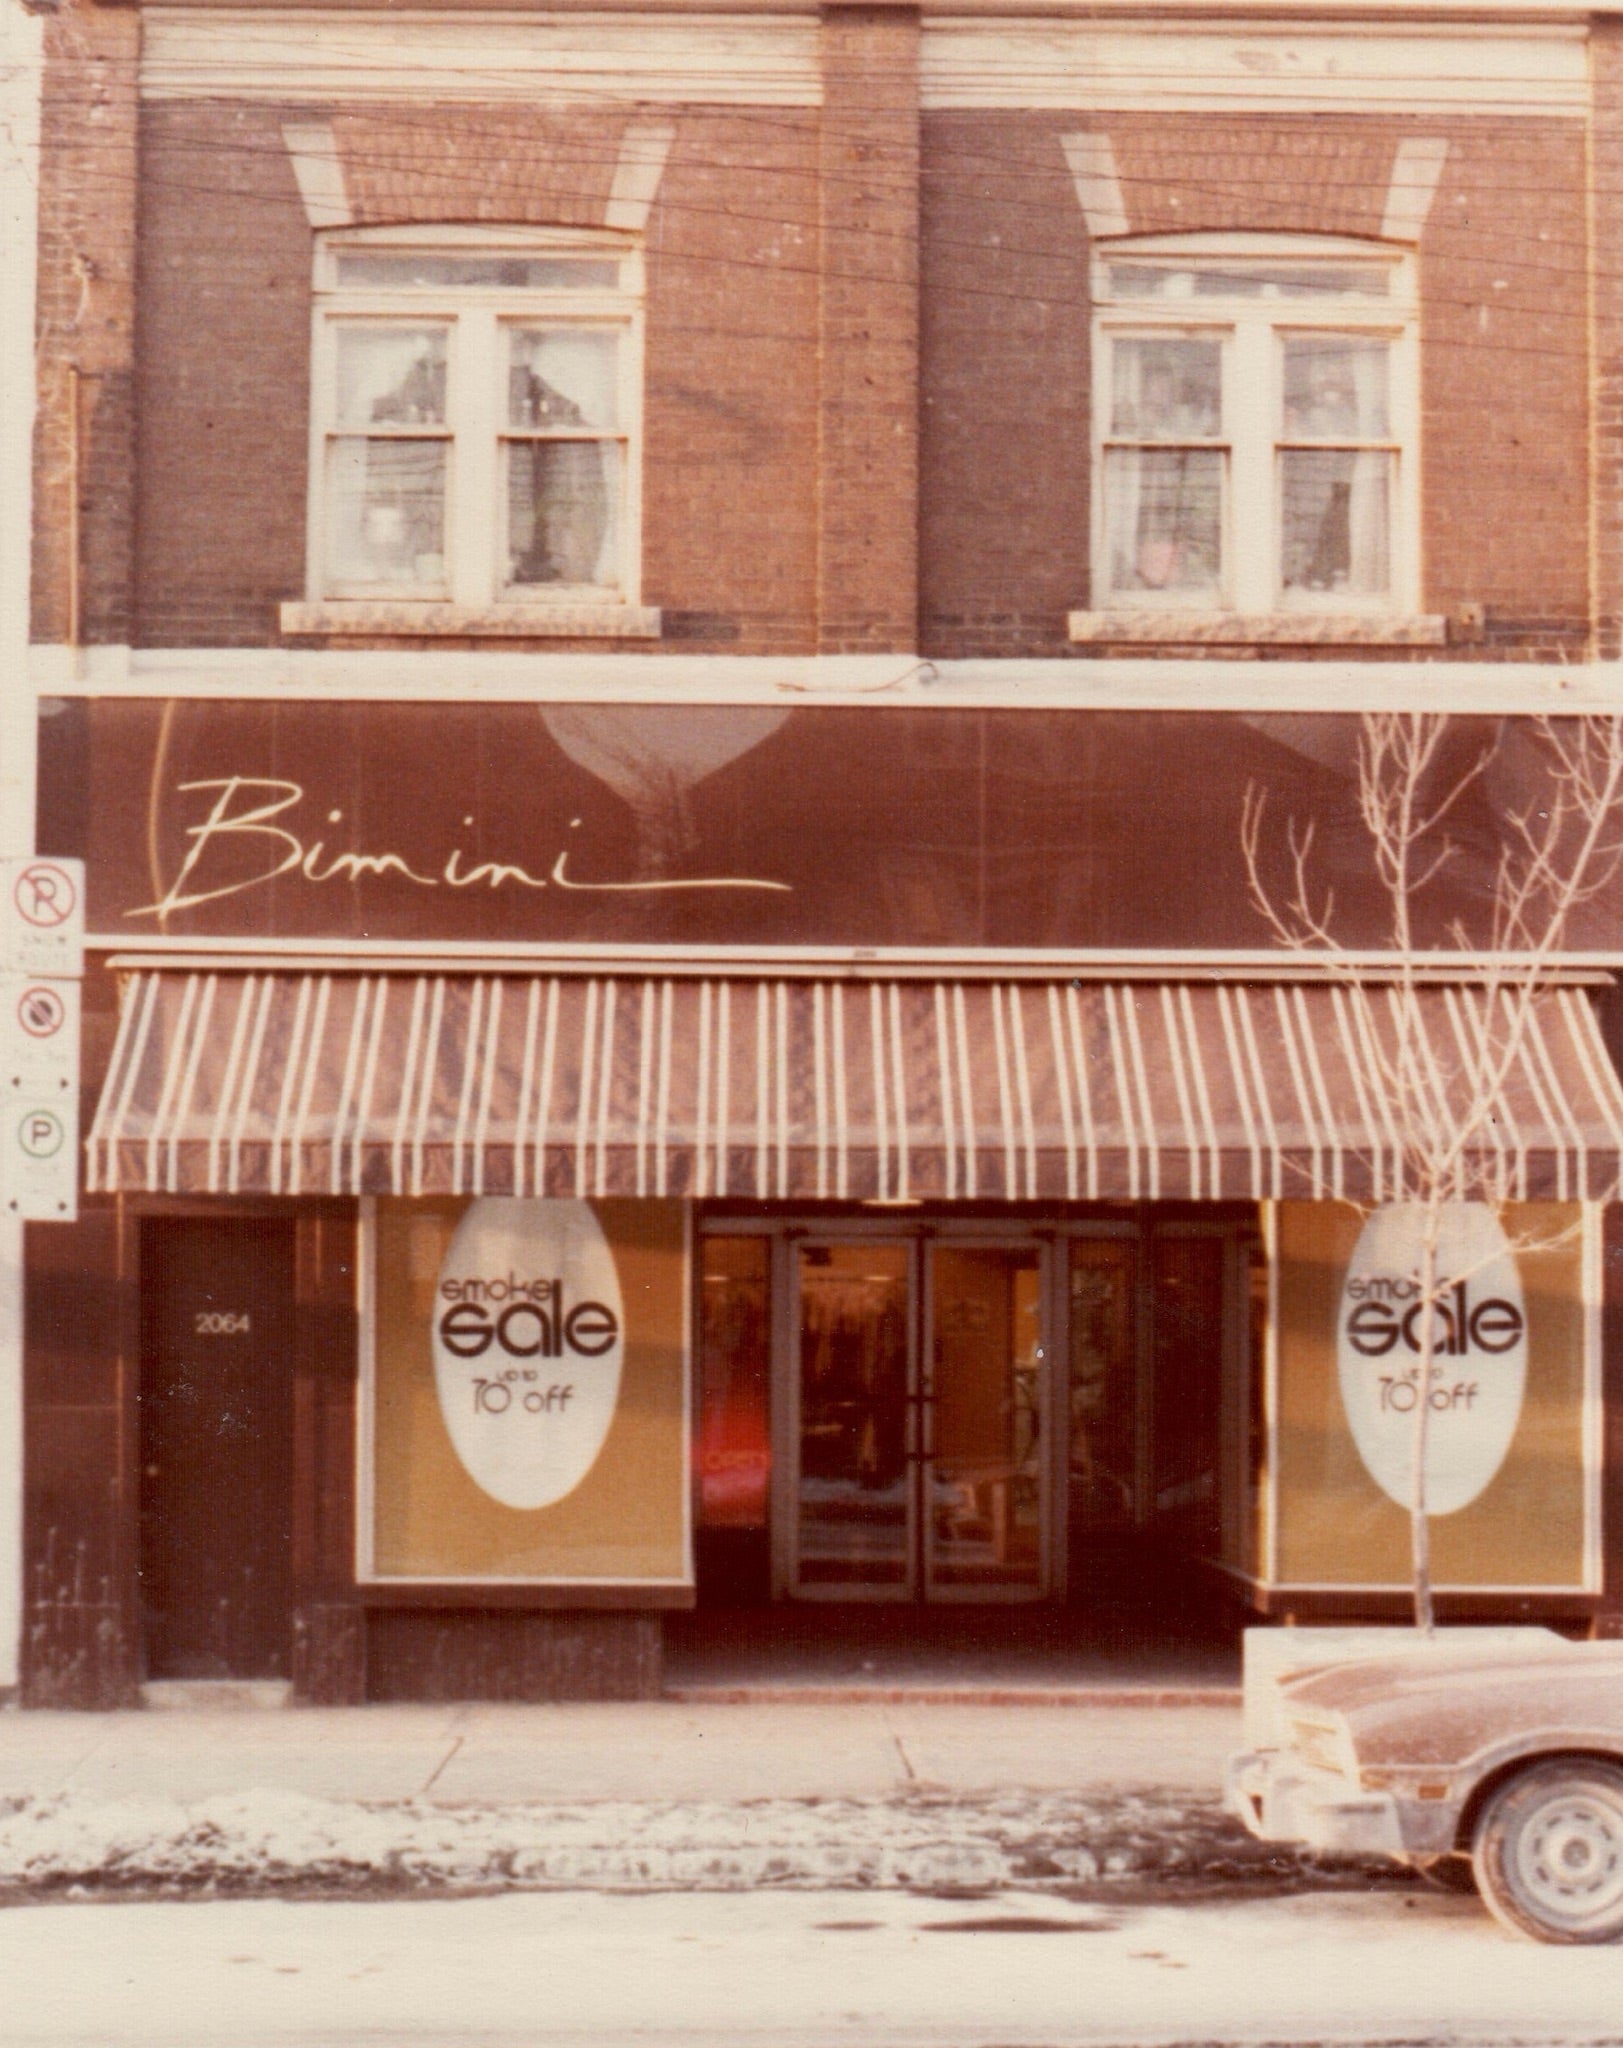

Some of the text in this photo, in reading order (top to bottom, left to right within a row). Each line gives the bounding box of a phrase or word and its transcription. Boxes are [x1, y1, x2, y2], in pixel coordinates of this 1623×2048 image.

[122, 775, 793, 920] Bimini
[441, 1270, 555, 1300] smoke
[195, 1312, 250, 1334] 2064
[440, 1278, 617, 1358] sale
[1347, 1280, 1523, 1357] sale
[523, 1384, 573, 1413] off
[1430, 1382, 1478, 1411] off
